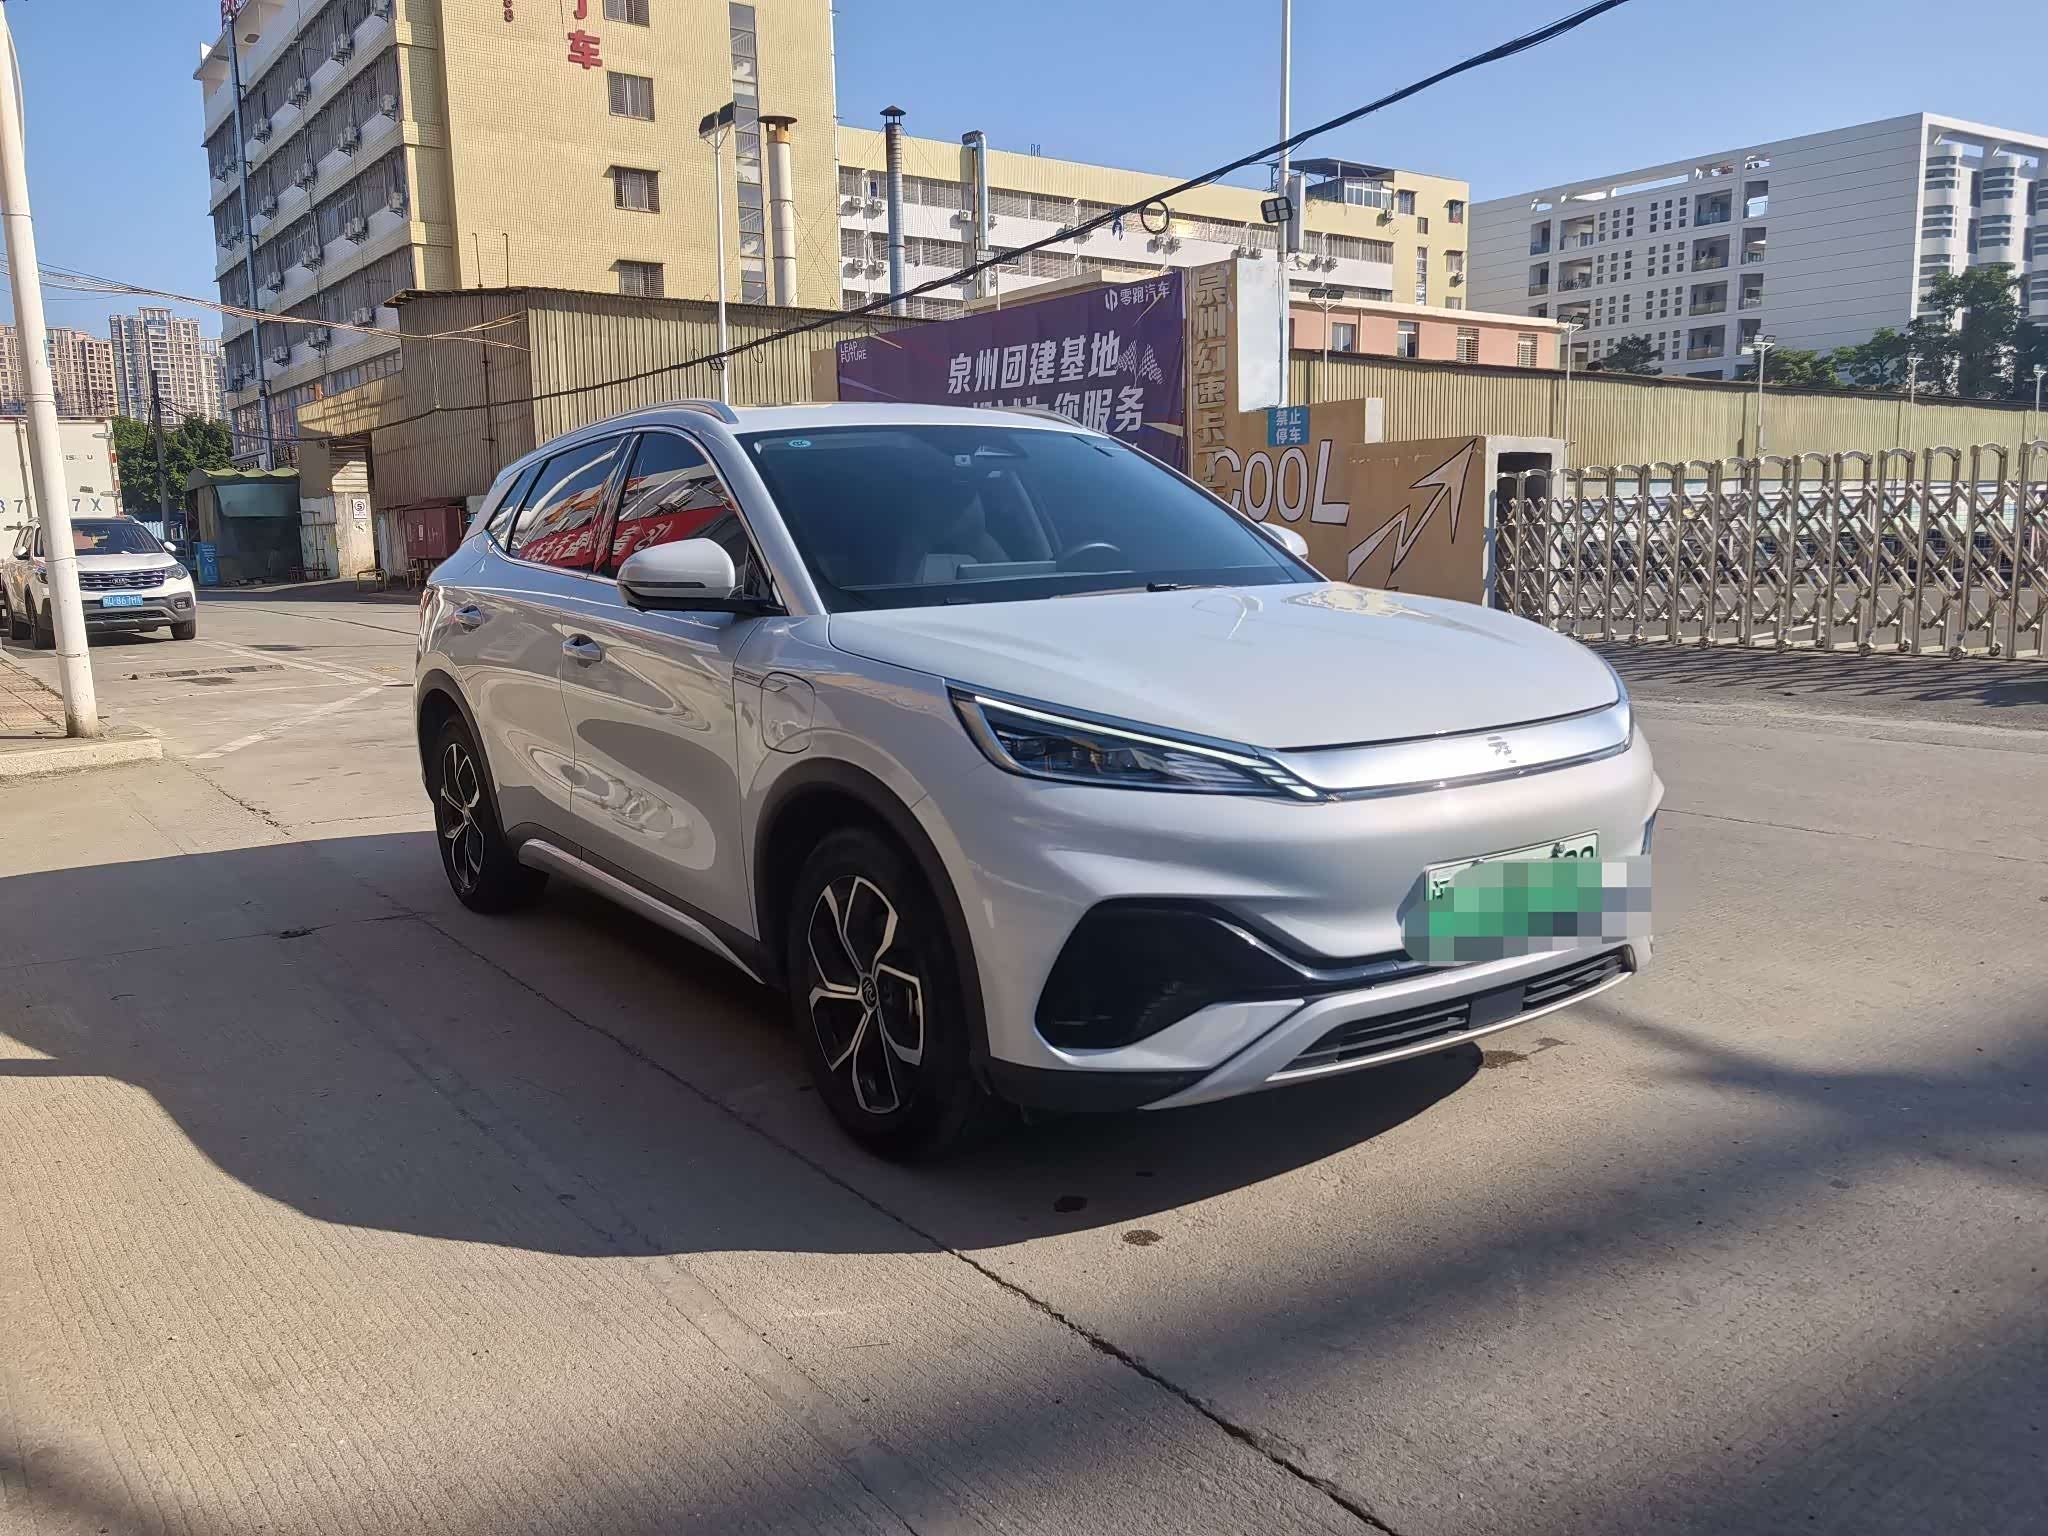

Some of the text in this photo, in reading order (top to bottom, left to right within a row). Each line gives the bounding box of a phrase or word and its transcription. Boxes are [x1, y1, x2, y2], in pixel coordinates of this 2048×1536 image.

[1120, 281, 1170, 305] 零跑汽车
[840, 341, 858, 353] LEAP
[840, 349, 867, 363] FUTURE
[947, 330, 1121, 394] 泉州团建基地
[1275, 410, 1302, 427] 禁止
[1275, 428, 1302, 445] 停车
